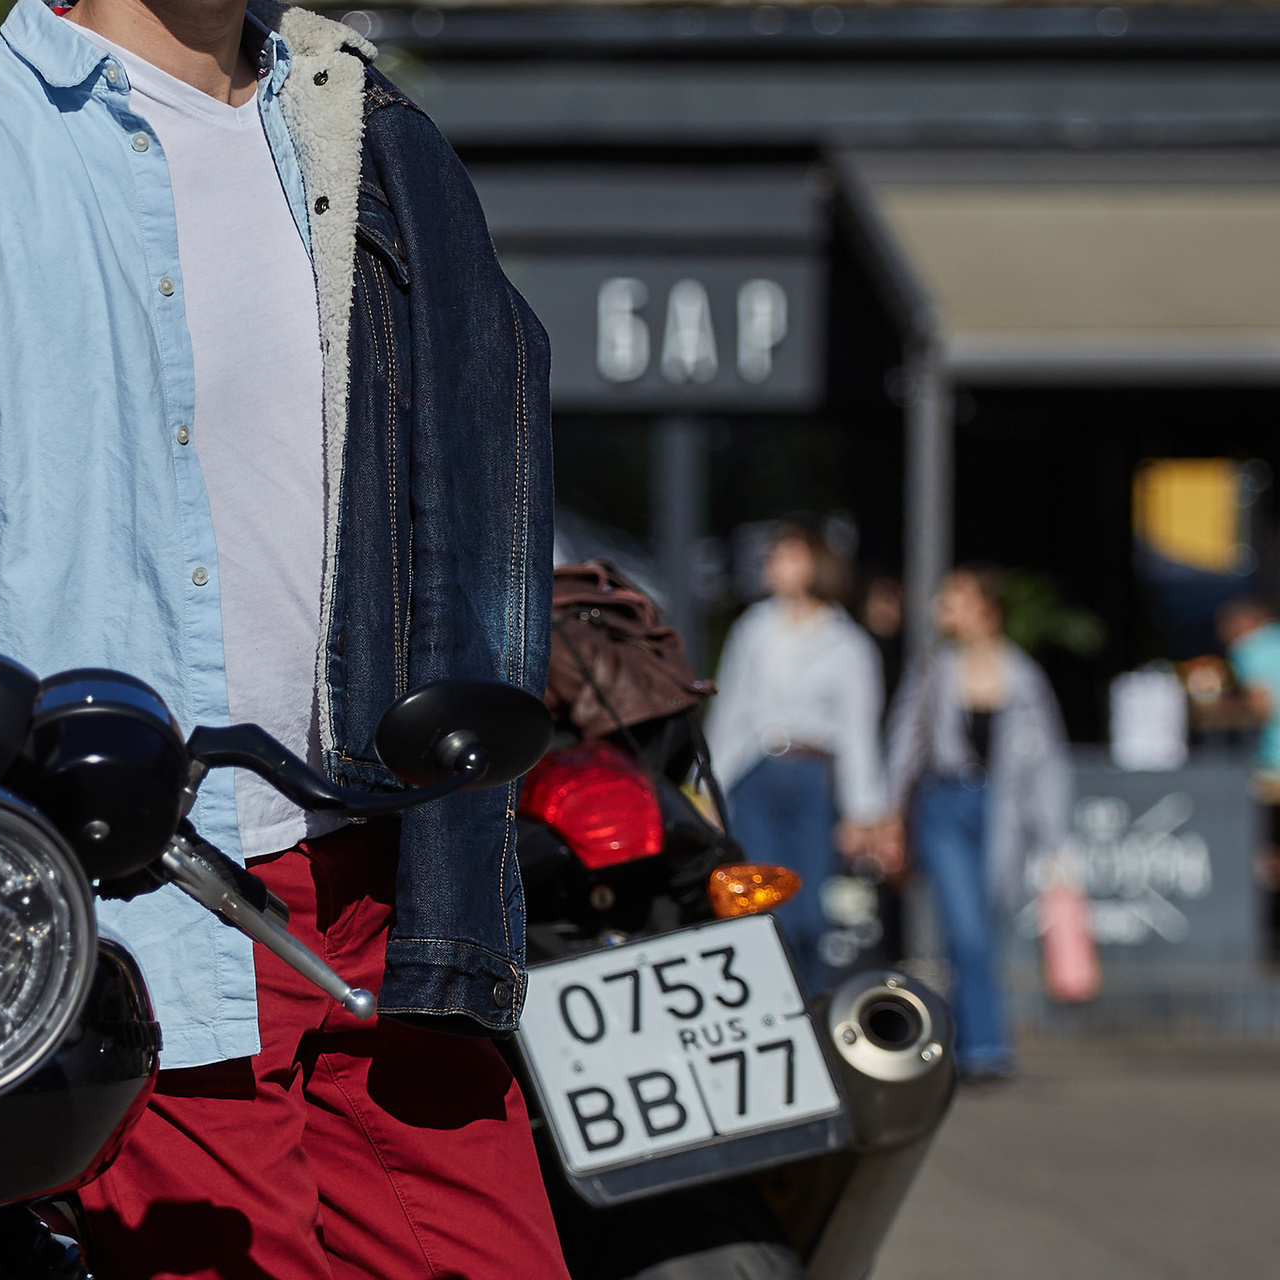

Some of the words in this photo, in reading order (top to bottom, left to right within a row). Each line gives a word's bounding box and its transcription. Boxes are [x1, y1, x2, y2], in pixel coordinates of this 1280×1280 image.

[596, 277, 788, 384] БАР
[558, 945, 750, 1045] 0753
[679, 1019, 747, 1051] RUS
[708, 1038, 795, 1117] 77
